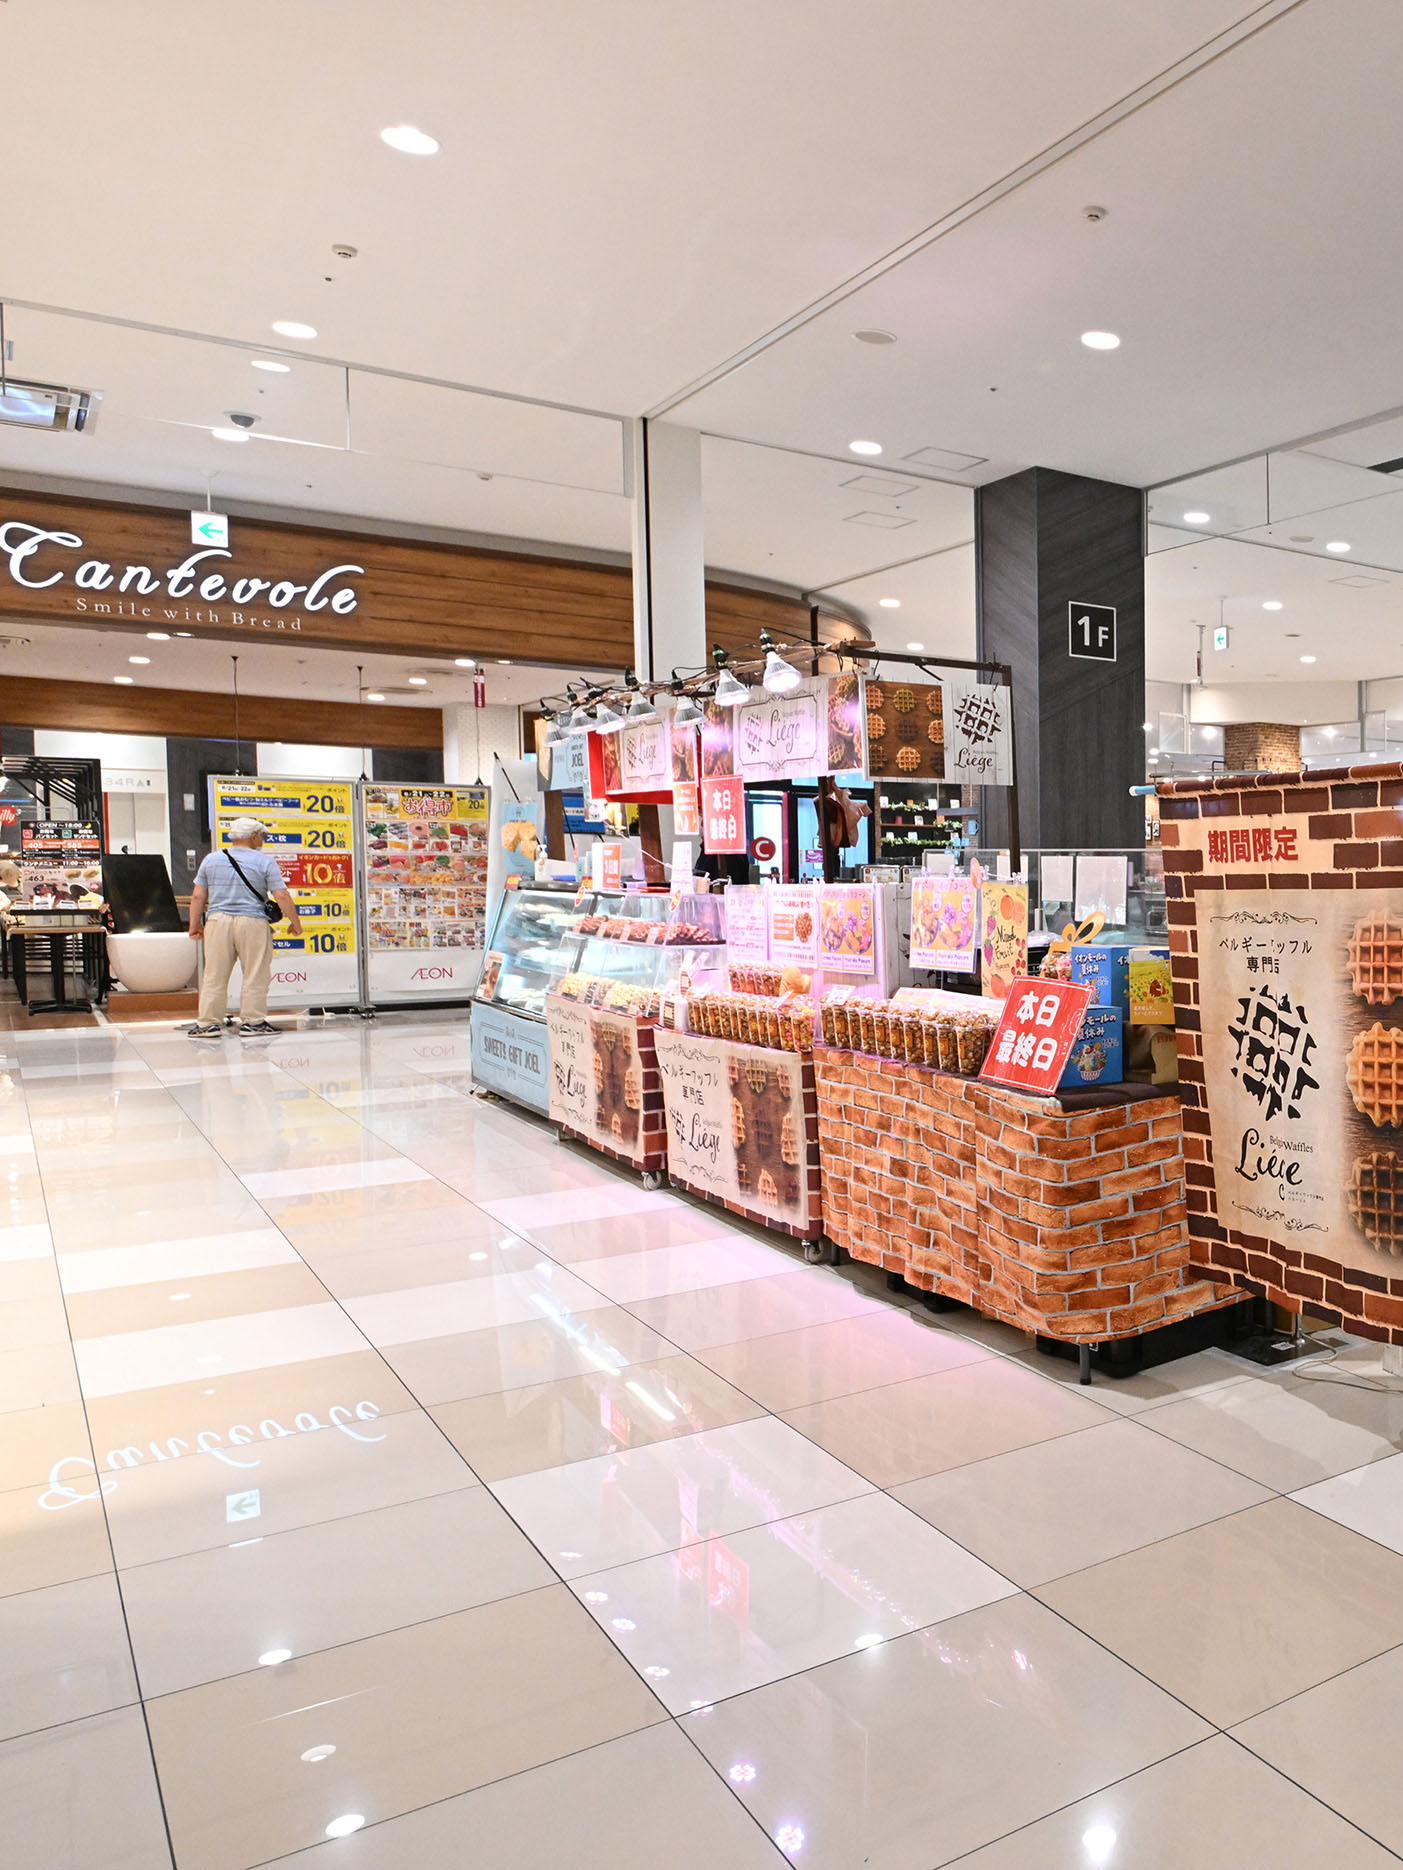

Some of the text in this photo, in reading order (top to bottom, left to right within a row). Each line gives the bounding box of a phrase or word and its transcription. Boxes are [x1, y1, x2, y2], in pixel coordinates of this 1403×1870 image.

[0, 522, 365, 615] Cantevole
[76, 597, 302, 631] Smile with Bread
[1077, 615, 1109, 647] 1F
[954, 747, 993, 773] Liége
[1208, 826, 1298, 863] 期間限定
[1075, 952, 1107, 964] イオンモールの
[1081, 963, 1099, 976] 夏休み
[1016, 990, 1060, 1028] 本日
[1079, 1015, 1117, 1027] ンモールの
[484, 1036, 506, 1060] SWEETS
[508, 1044, 523, 1066] GIFT
[995, 1029, 1058, 1071] 最終日
[1282, 1141, 1314, 1153] Waffles
